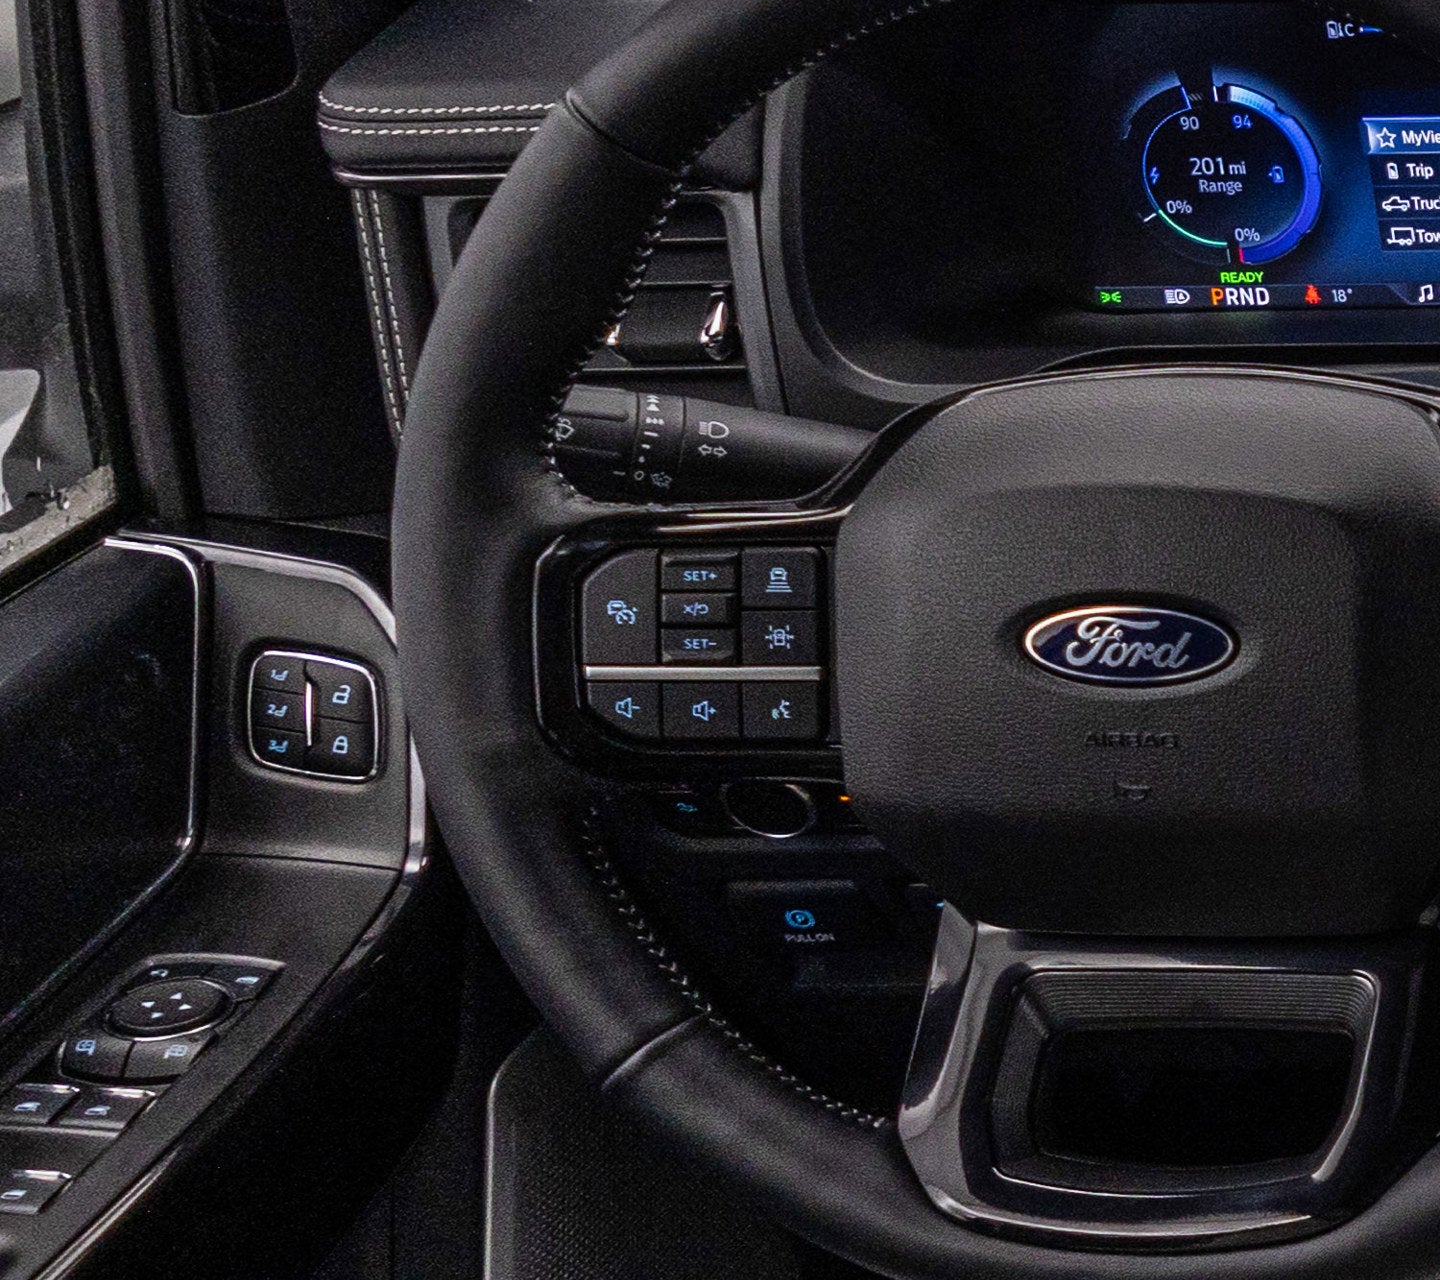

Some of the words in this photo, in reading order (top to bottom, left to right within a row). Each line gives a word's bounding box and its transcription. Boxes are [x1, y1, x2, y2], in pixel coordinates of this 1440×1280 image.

[1345, 24, 1355, 37] C
[1180, 116, 1200, 130] 90
[1232, 115, 1252, 129] 94
[1189, 157, 1224, 176] 201
[1228, 161, 1246, 175] mi
[1406, 164, 1433, 179] Trip
[1199, 179, 1243, 196] Range
[1166, 200, 1192, 214] 0%
[1235, 228, 1260, 242] 0%
[1220, 271, 1264, 283] READY
[1331, 288, 1353, 303] 18°
[683, 570, 718, 581] SET+
[1066, 615, 1192, 669] Ford
